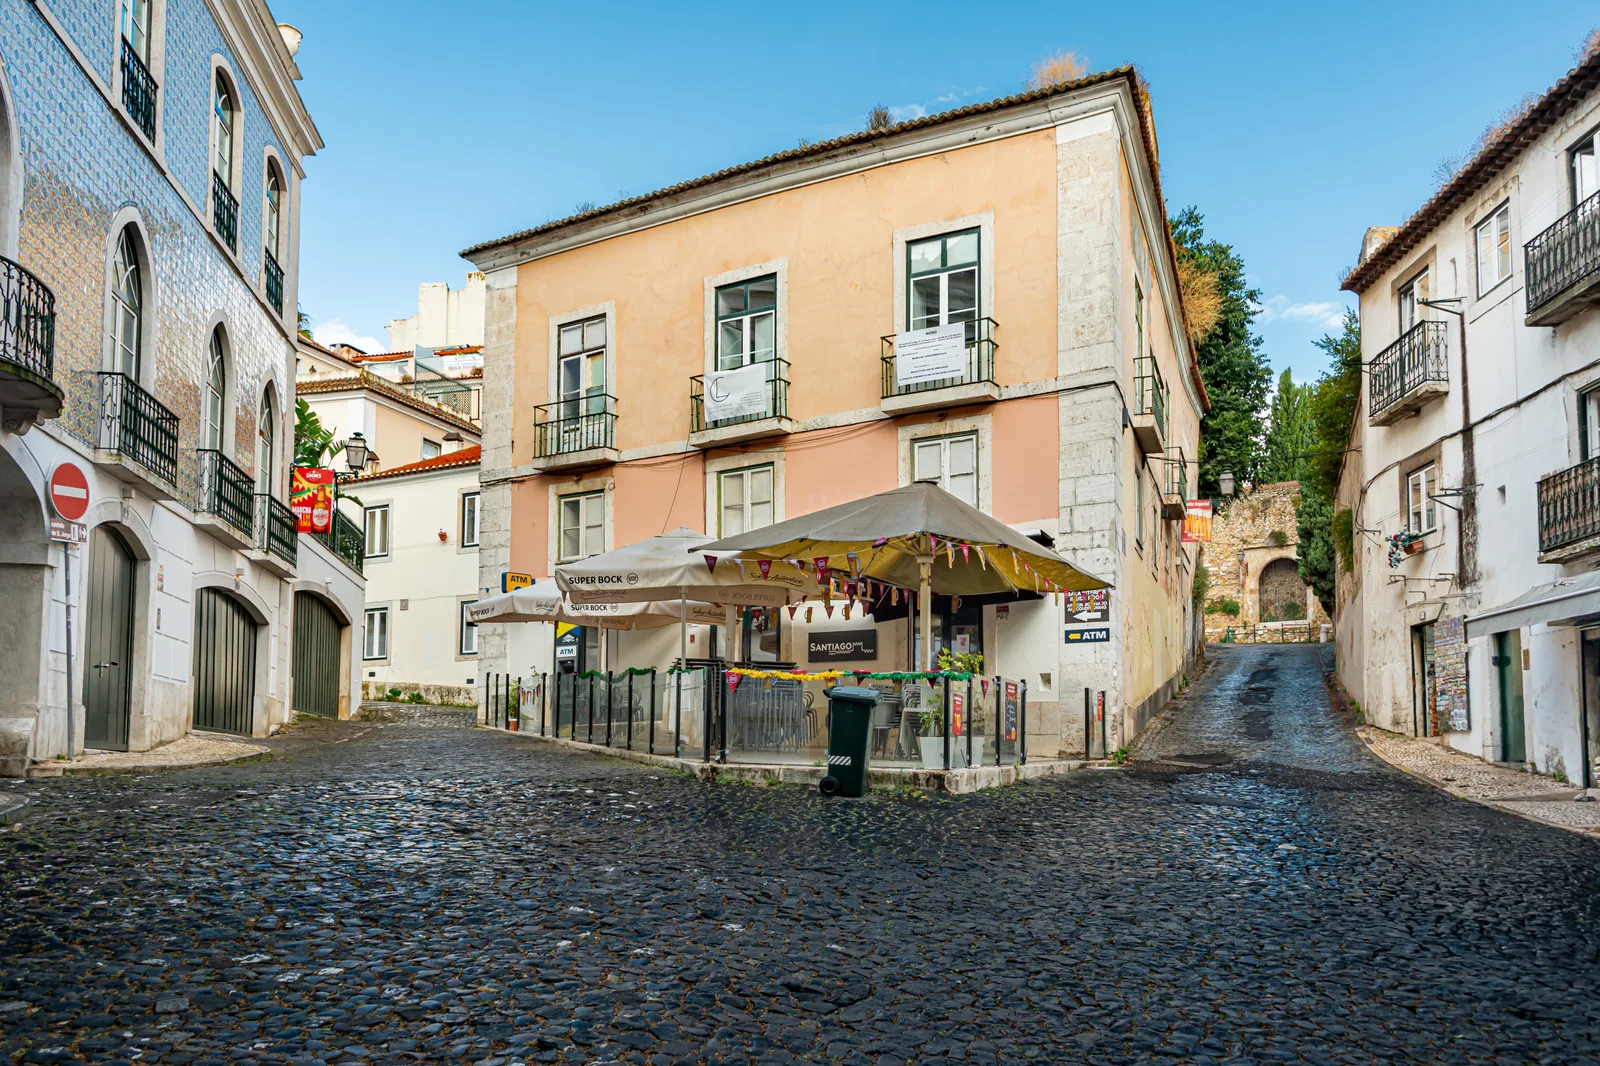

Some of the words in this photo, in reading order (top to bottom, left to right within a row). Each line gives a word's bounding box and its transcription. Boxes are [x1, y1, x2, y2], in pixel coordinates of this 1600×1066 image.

[510, 575, 528, 584] ATM
[569, 576, 596, 585] SUPER
[598, 575, 623, 584] BOCK
[1082, 630, 1107, 640] ATM
[810, 642, 853, 652] SANTIAGO
